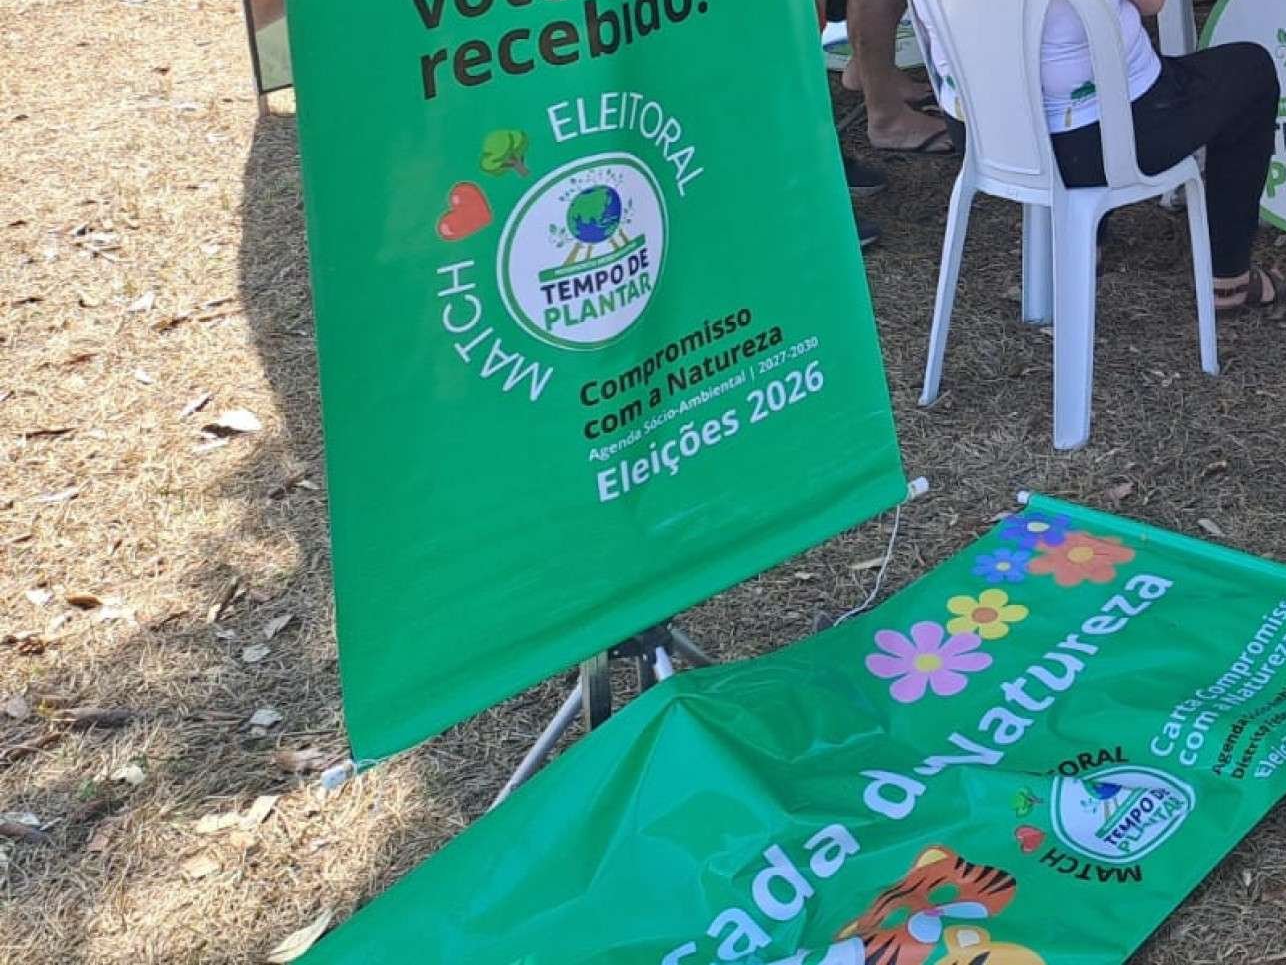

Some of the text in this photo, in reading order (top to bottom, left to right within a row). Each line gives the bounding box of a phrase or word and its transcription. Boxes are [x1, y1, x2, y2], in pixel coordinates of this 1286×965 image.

[547, 91, 704, 197] ELEITORAL
[540, 248, 649, 304] TEMPO DE
[544, 271, 652, 330] PLANTAR
[437, 259, 554, 402] MATCH
[580, 308, 752, 406] Compromisso
[584, 325, 784, 439] com a Natureza
[589, 429, 642, 461] Agenda
[758, 336, 819, 374] 2027-2030
[597, 360, 825, 502] Eleições 2026
[1179, 709, 1219, 766] com
[1039, 847, 1143, 884] MATCH
[1104, 797, 1154, 846] TEMPO
